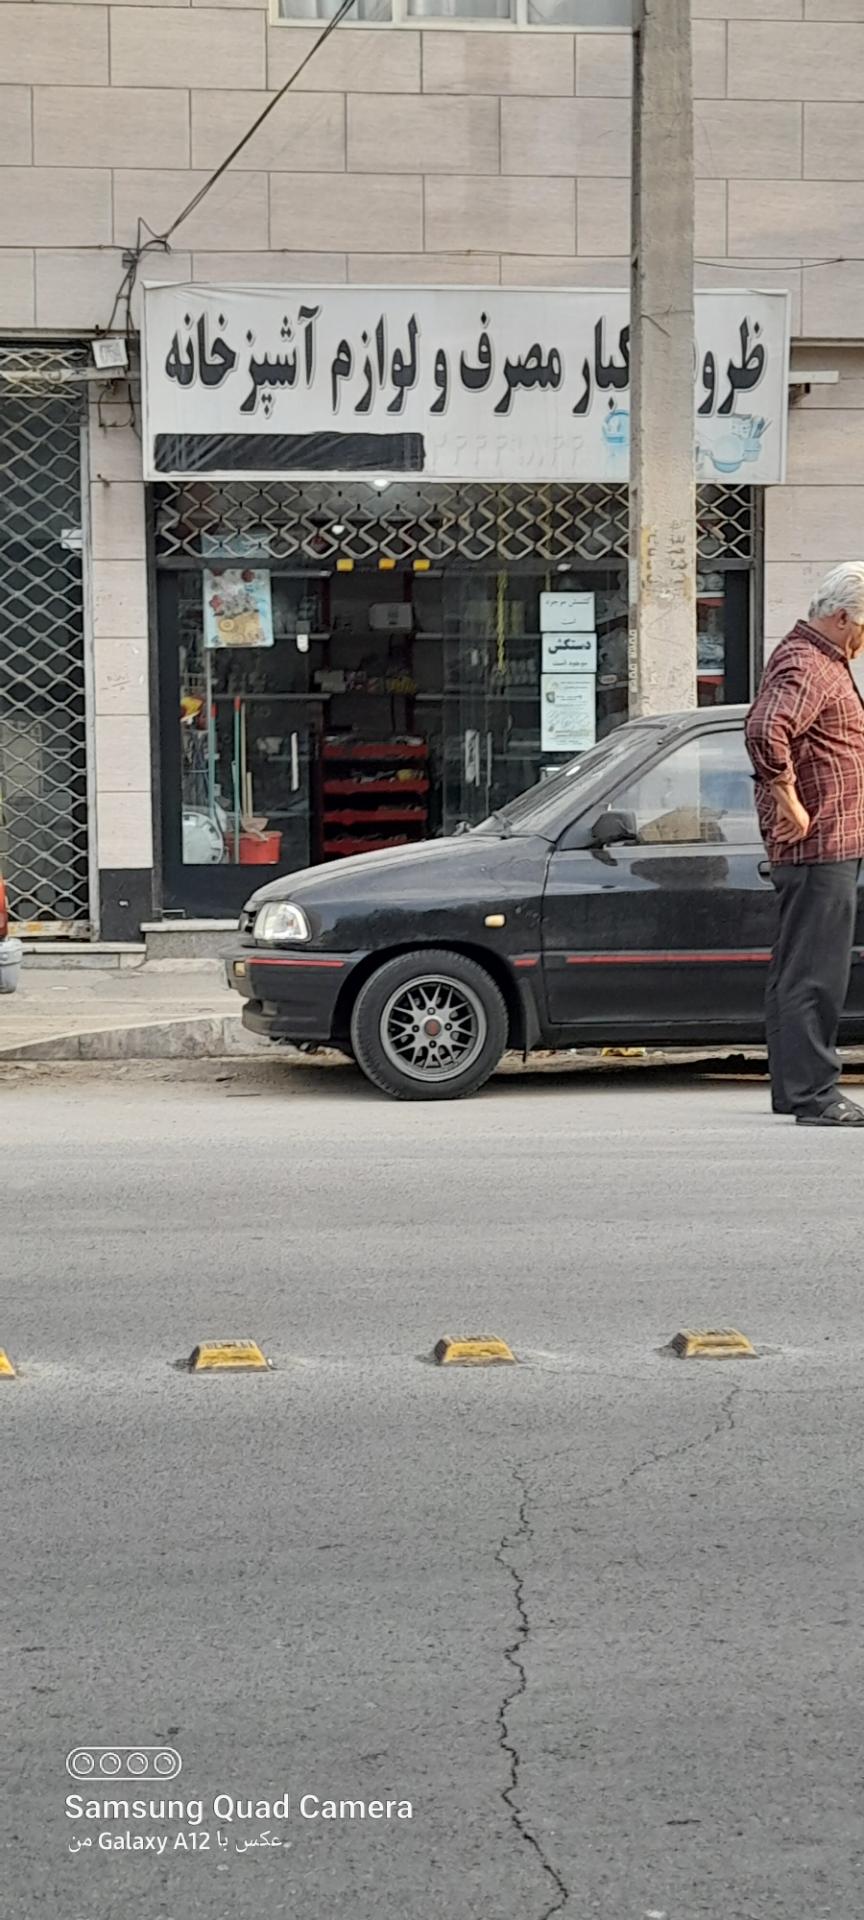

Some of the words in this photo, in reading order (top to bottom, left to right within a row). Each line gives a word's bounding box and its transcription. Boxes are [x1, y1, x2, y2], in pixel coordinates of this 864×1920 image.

[165, 305, 319, 415] آشپزخانه
[331, 314, 418, 413] لوازم
[429, 348, 448, 413] و
[459, 312, 562, 414] مصرف
[547, 638, 592, 655] دستکش
